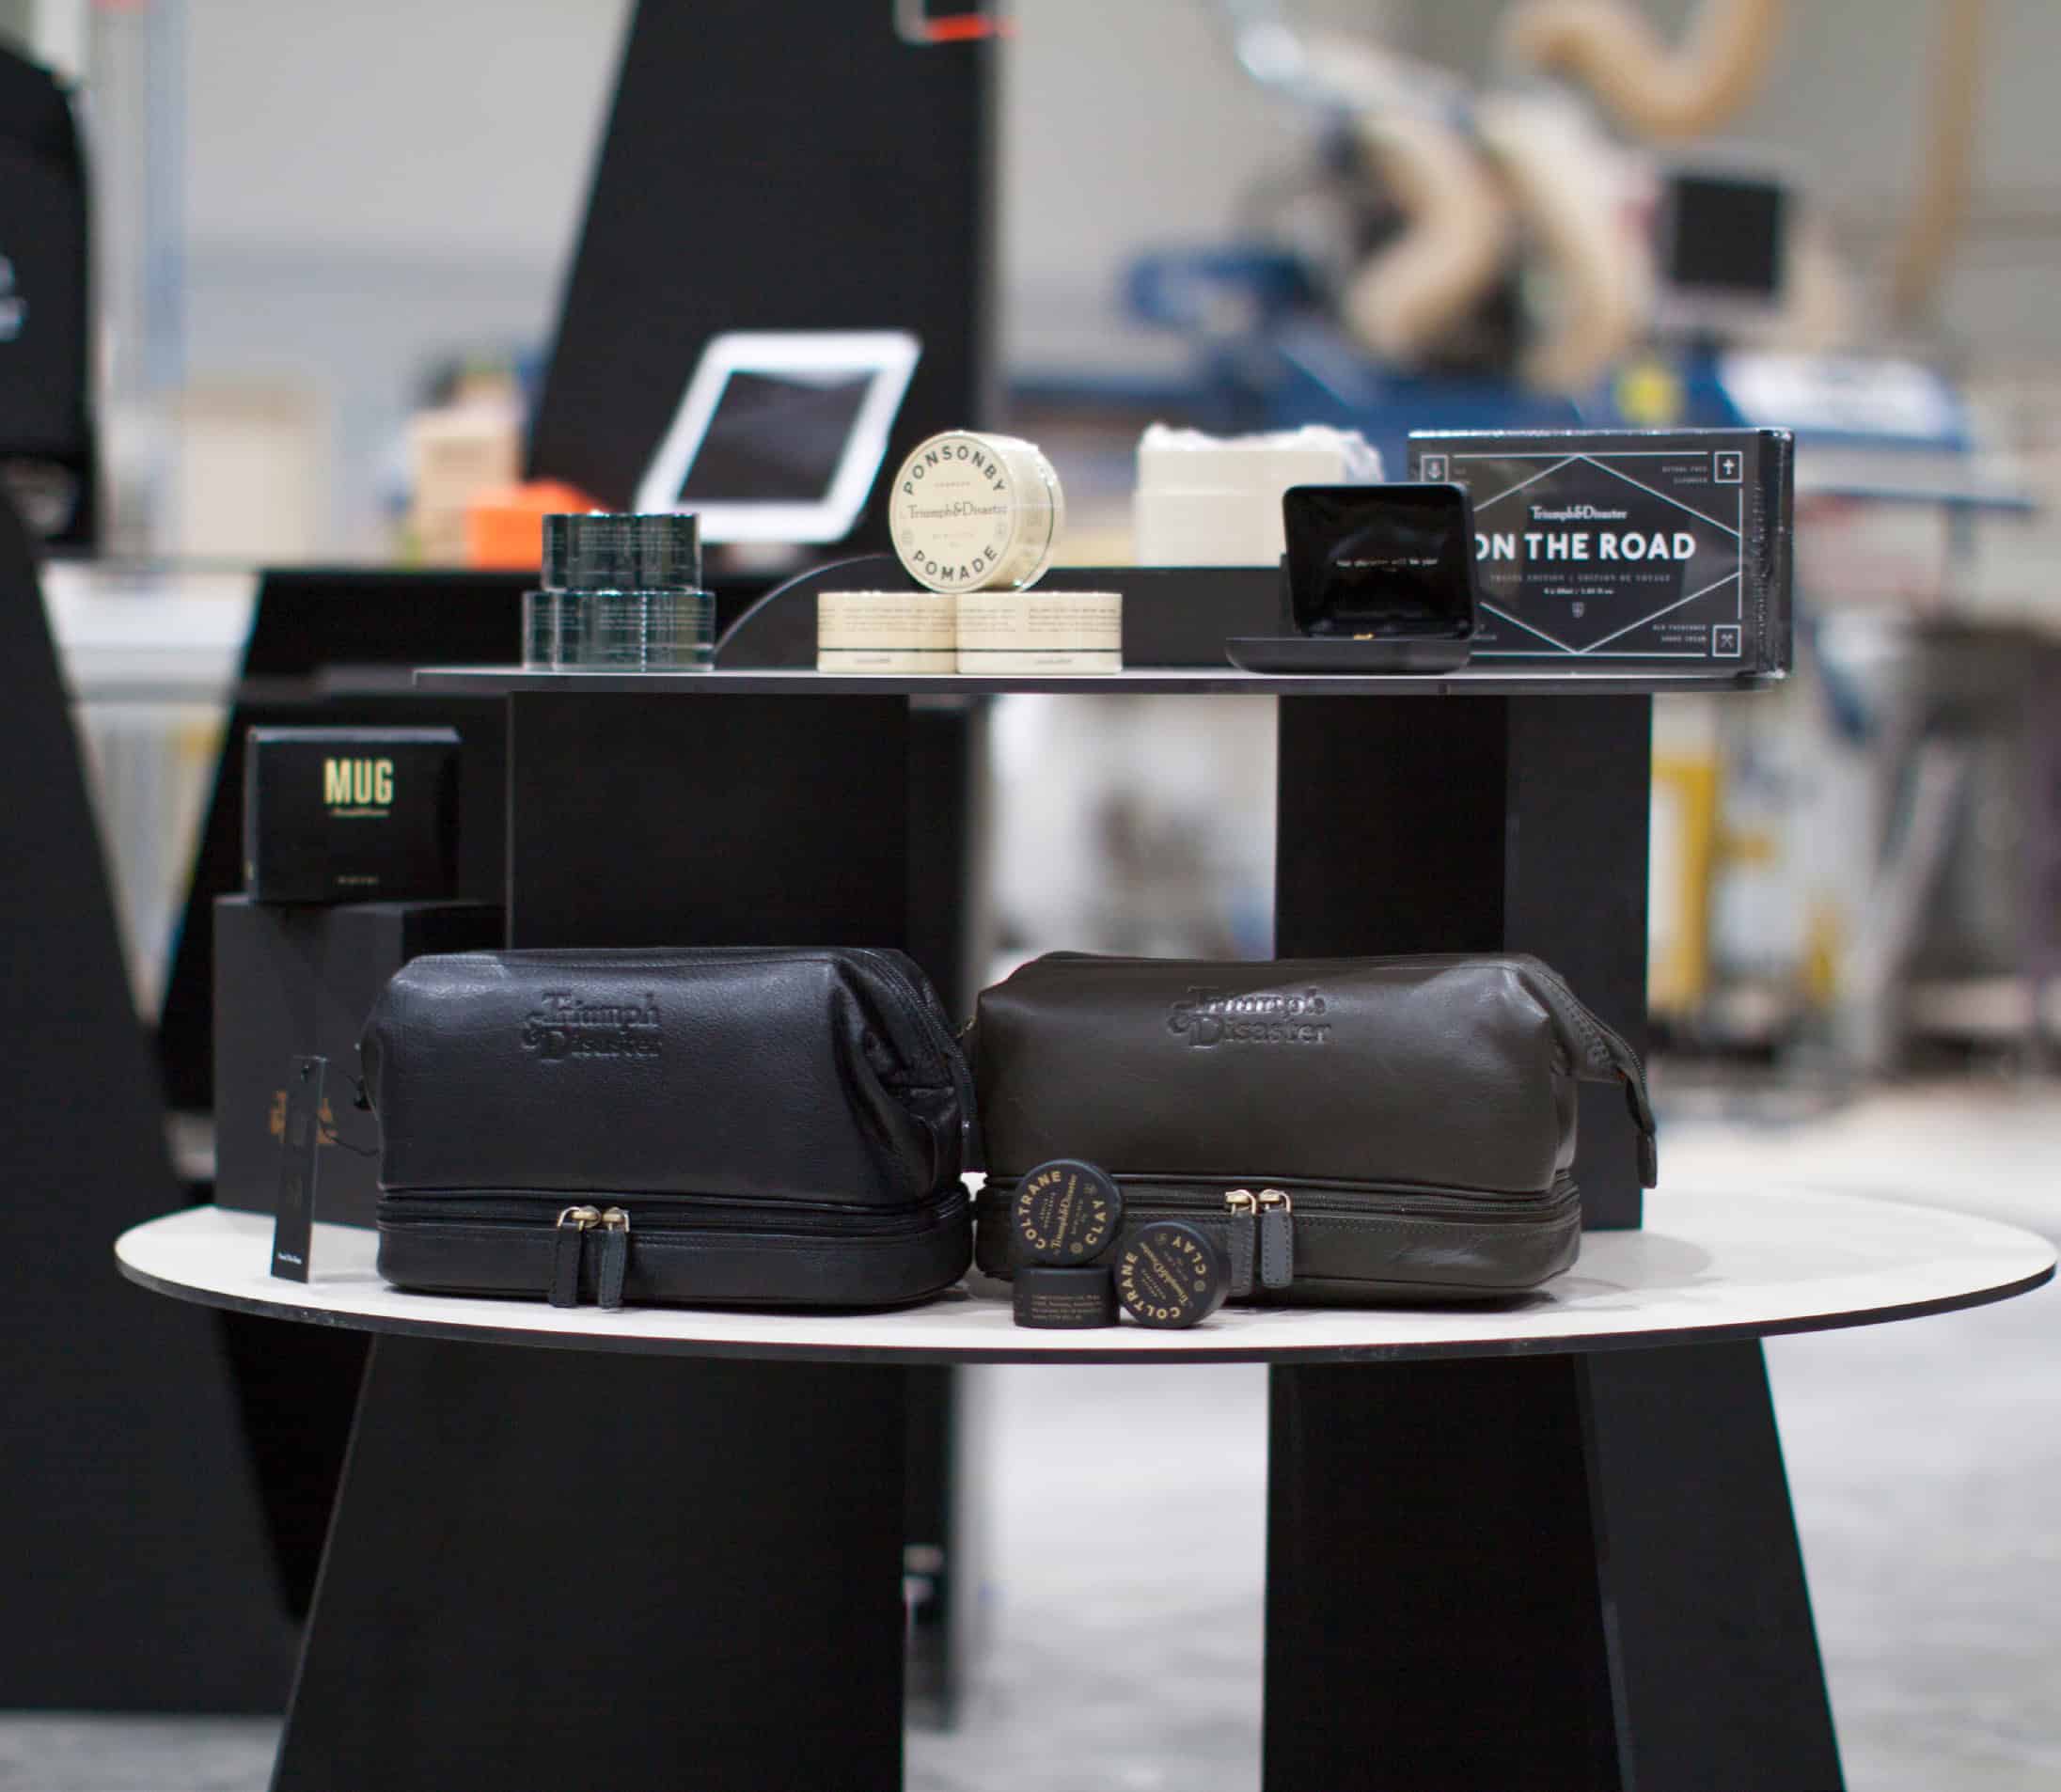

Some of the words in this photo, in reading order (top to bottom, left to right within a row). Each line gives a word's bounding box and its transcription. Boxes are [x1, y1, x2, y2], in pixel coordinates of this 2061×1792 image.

[903, 445, 1006, 496] PONSONBY
[912, 545, 998, 582] POMADE
[1524, 533, 1590, 560] THE
[1599, 532, 1696, 560] ROAD
[324, 758, 393, 805] MUG
[541, 992, 661, 1030] Triumph
[1188, 986, 1326, 1023] Triumph
[1188, 1018, 1332, 1051] Disaster
[1017, 1171, 1062, 1250] COLTRANE
[1085, 1200, 1107, 1246] CLAY
[1172, 1235, 1207, 1276] CLAY
[1120, 1251, 1181, 1319] COLTRANE
